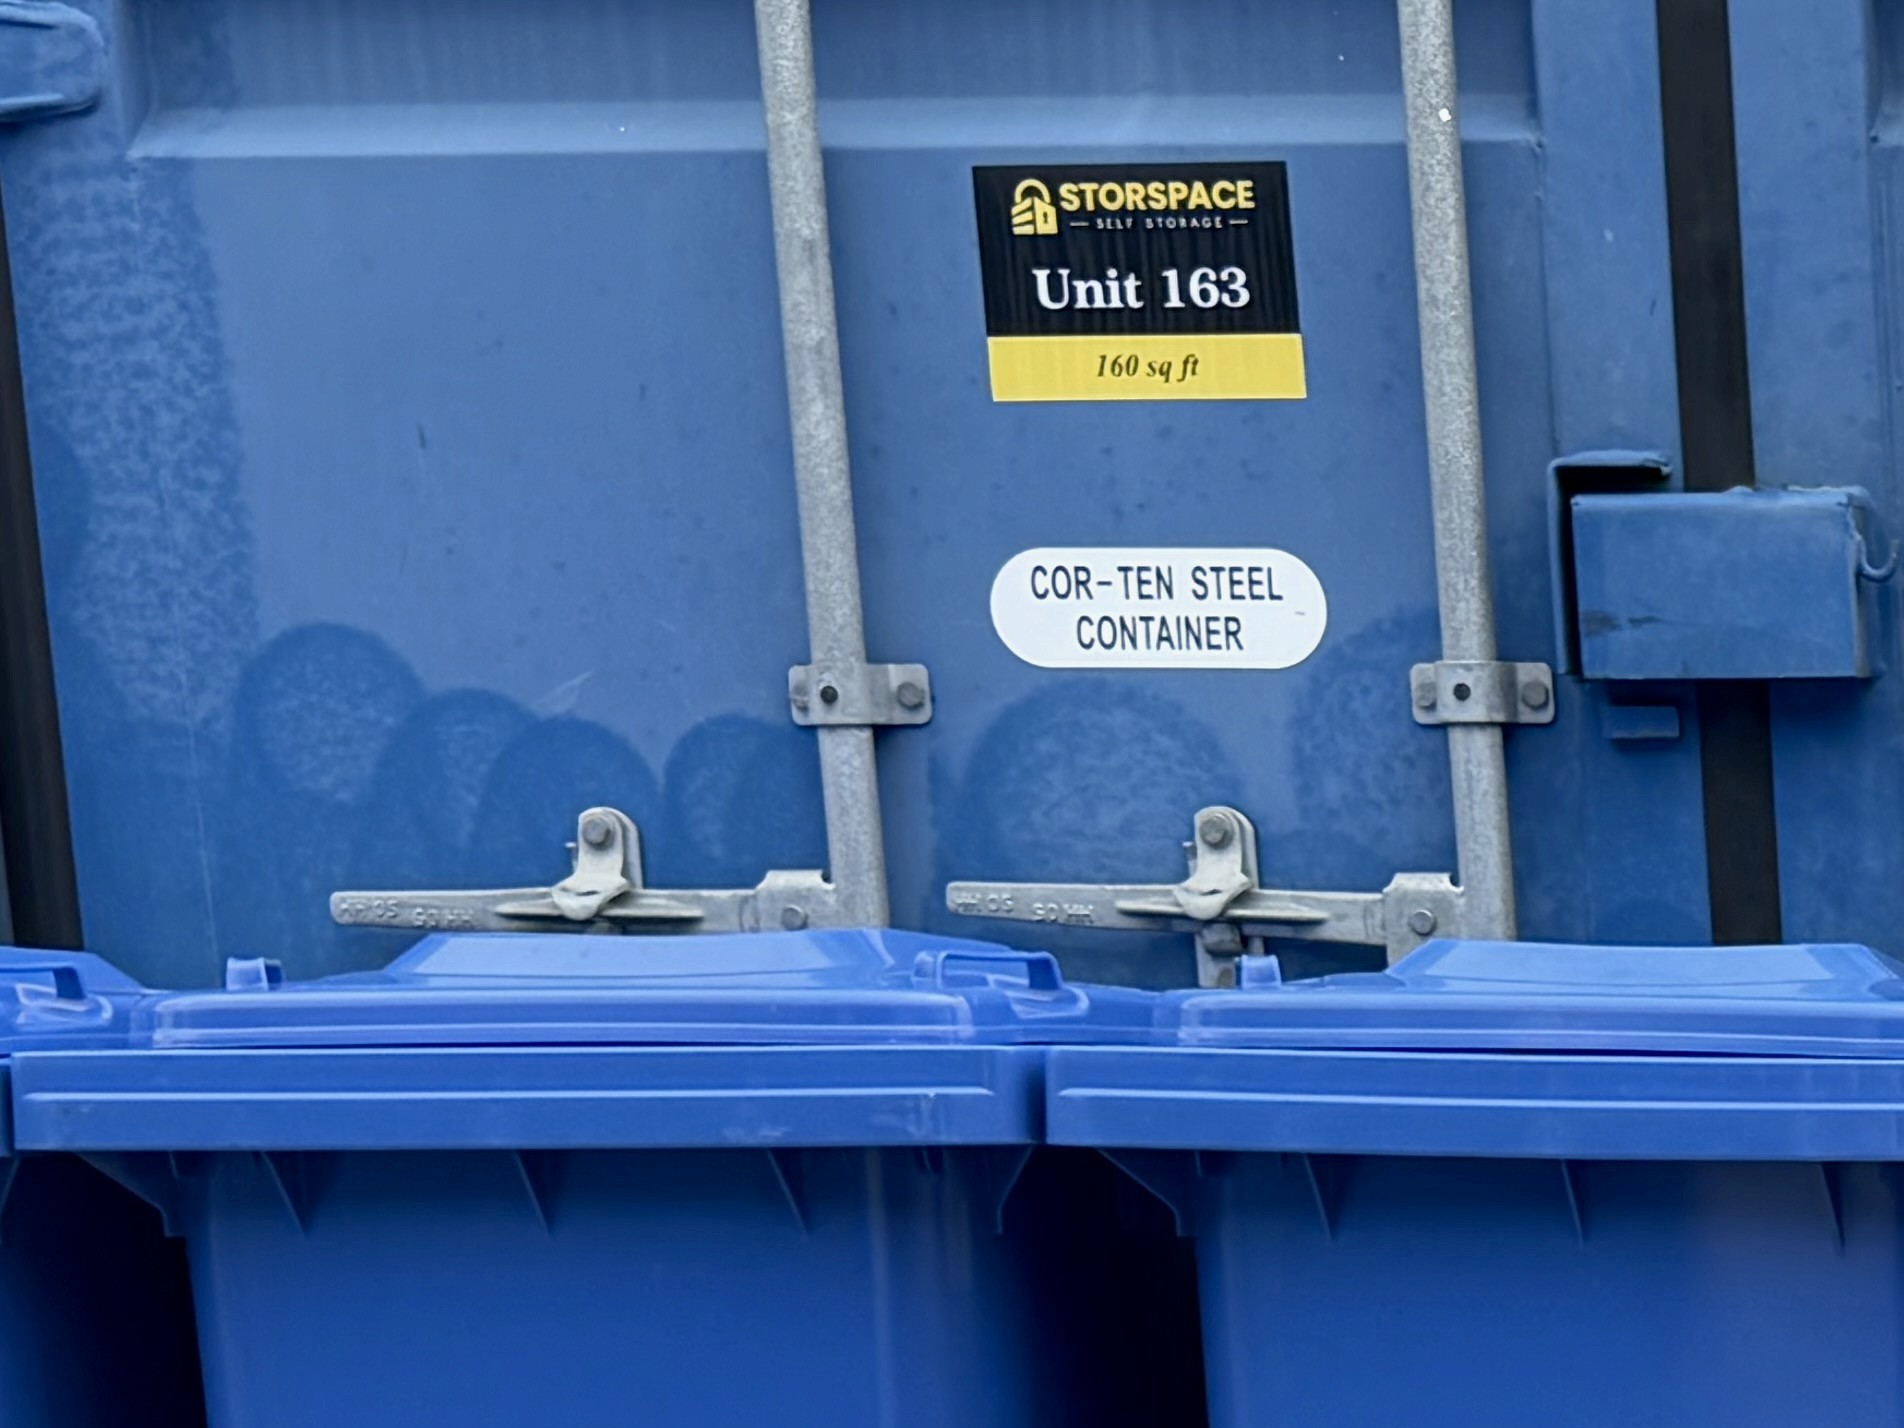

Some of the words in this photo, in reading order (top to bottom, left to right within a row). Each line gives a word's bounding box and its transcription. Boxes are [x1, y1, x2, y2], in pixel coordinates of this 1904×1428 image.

[1058, 179, 1256, 212] STORSPACE
[1095, 217, 1134, 230] SELF
[1145, 216, 1224, 230] STORAGE
[1031, 266, 1145, 310] Unit
[1160, 265, 1251, 309] 163
[1096, 353, 1140, 378] 160
[1145, 360, 1173, 384] sq
[1175, 352, 1200, 383] ft
[1030, 564, 1175, 601] COR-TEN
[1191, 565, 1284, 601] STEEL
[1076, 614, 1244, 651] CONTAINER
